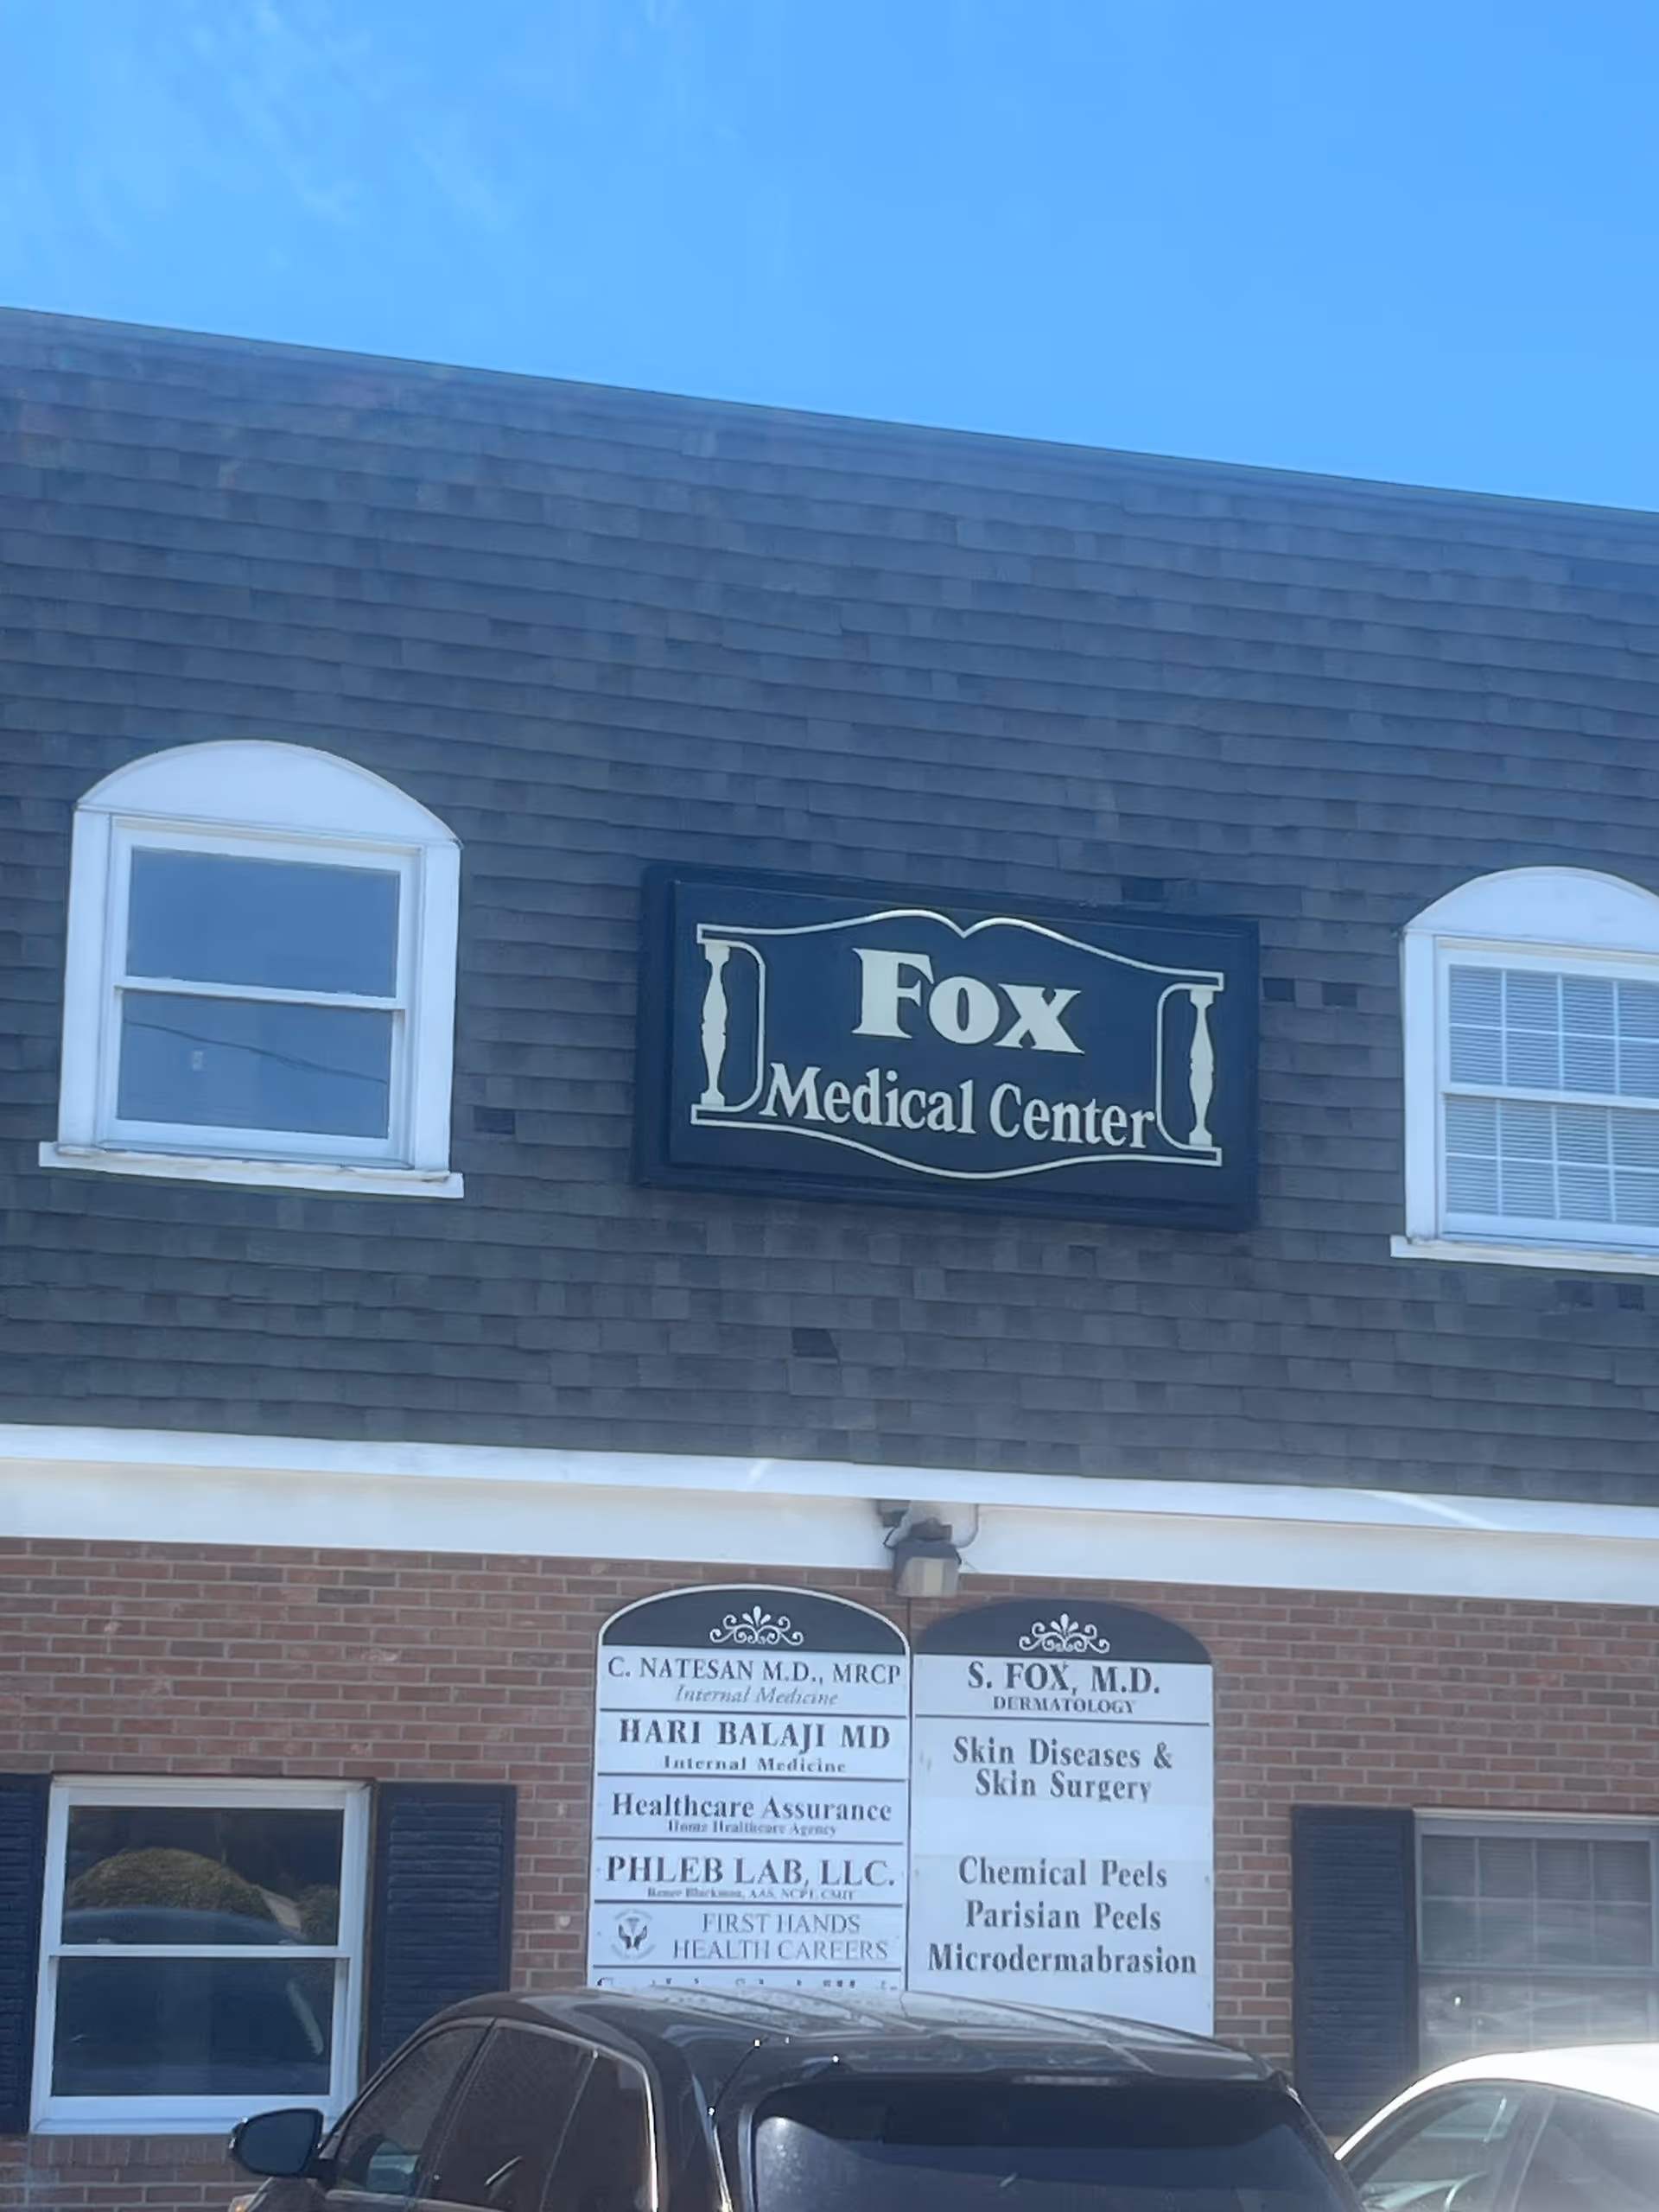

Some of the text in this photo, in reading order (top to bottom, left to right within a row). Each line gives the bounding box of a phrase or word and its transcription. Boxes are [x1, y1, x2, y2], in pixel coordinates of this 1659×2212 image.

[852, 948, 1084, 1054] Fox
[759, 1062, 1155, 1148] Medical Center
[607, 1656, 631, 1678] C.
[639, 1657, 753, 1681] NATESAN
[833, 1662, 901, 1685] MRCP
[968, 1661, 1160, 1696] S. FOX, M.D.
[675, 1684, 838, 1706] Internal Medicine
[993, 1695, 1137, 1714] DERMATOLOGY
[620, 1718, 891, 1754] HARI BALAJI MD
[664, 1754, 846, 1774] Internal Medicine
[953, 1735, 1173, 1770] Skin Diseases &
[976, 1769, 1153, 1803] Skin Surgery
[612, 1792, 893, 1821] Healthcare Assurance
[713, 1819, 786, 1834] Healthcare
[790, 1822, 836, 1838] Agency
[606, 1855, 895, 1887] PHLEB LAB, LLC.
[958, 1855, 1168, 1888] Chemical Peels
[702, 1912, 861, 1935] FIRST HANDS
[965, 1899, 1161, 1930] Parisian Peels
[673, 1939, 770, 1961] HEALTH
[778, 1940, 888, 1961] CAREERS
[928, 1942, 1197, 1974] Microdermabrasion
